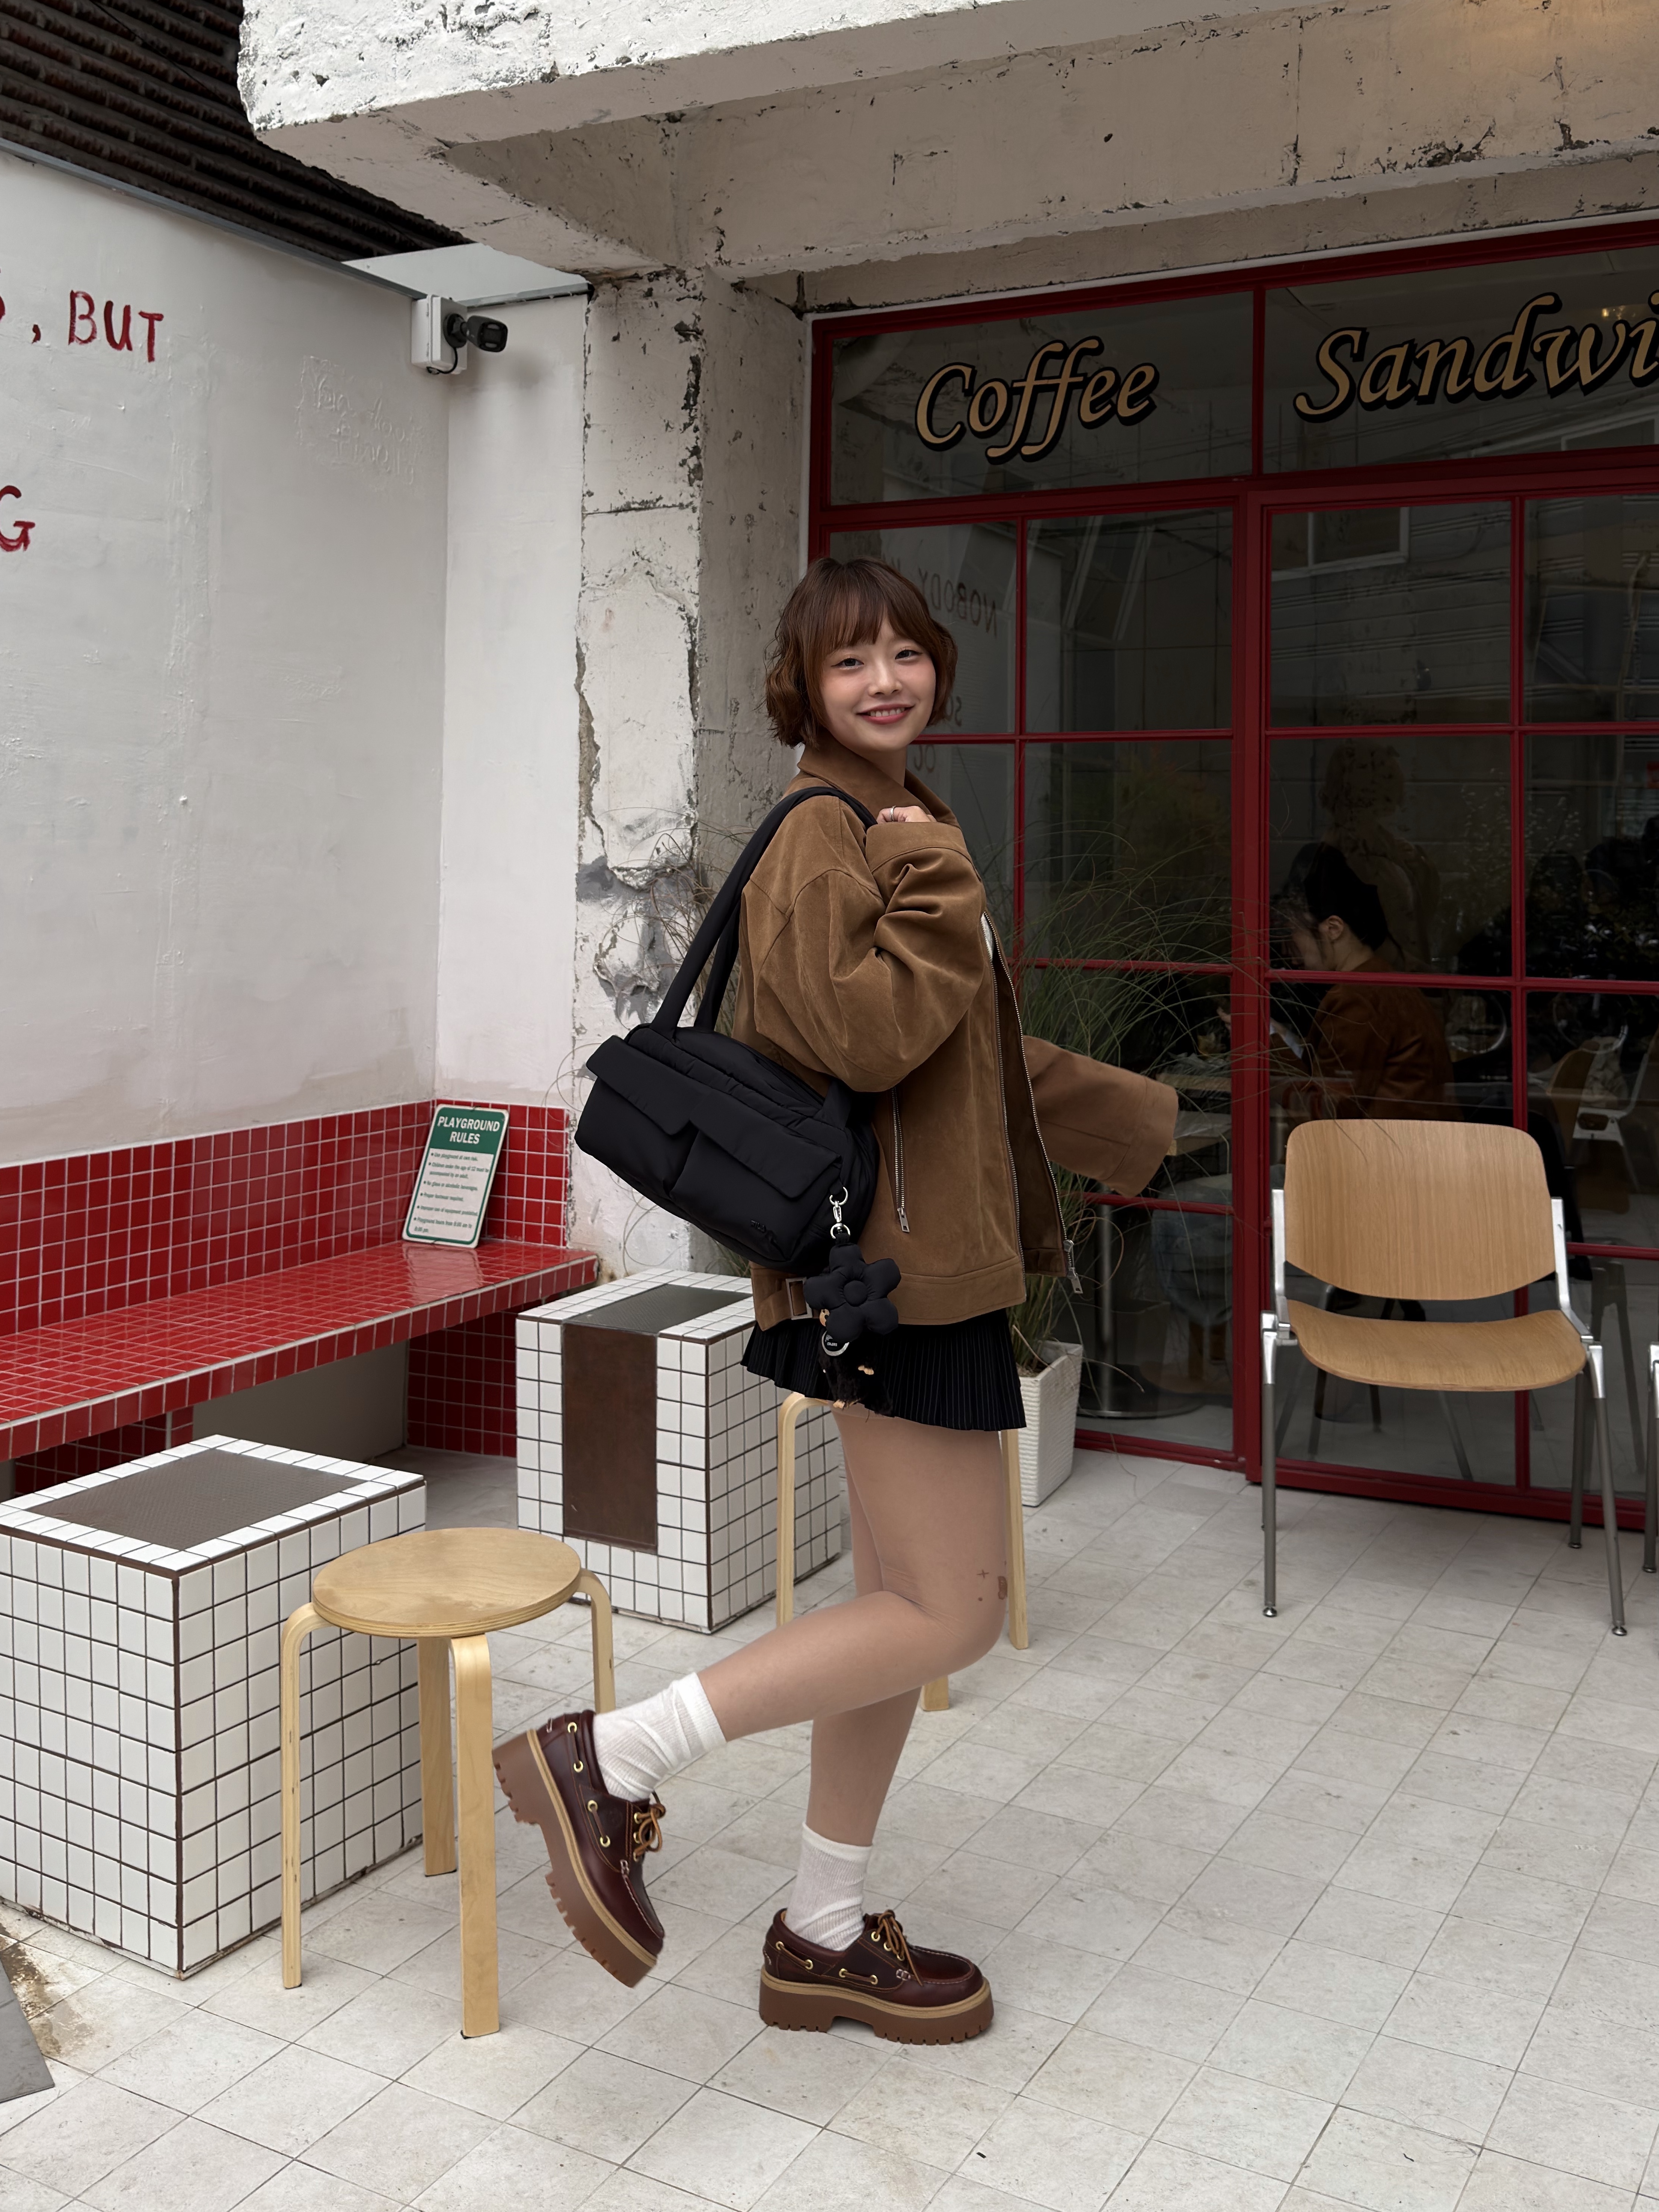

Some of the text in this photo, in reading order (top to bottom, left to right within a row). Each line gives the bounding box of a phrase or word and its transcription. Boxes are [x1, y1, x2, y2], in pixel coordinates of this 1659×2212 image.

[68, 290, 164, 362] BUT
[1293, 290, 1659, 423] Sandwi
[915, 336, 1159, 465] Coffee
[437, 1116, 500, 1132] PLAYGROUND
[450, 1131, 480, 1144] RULES
